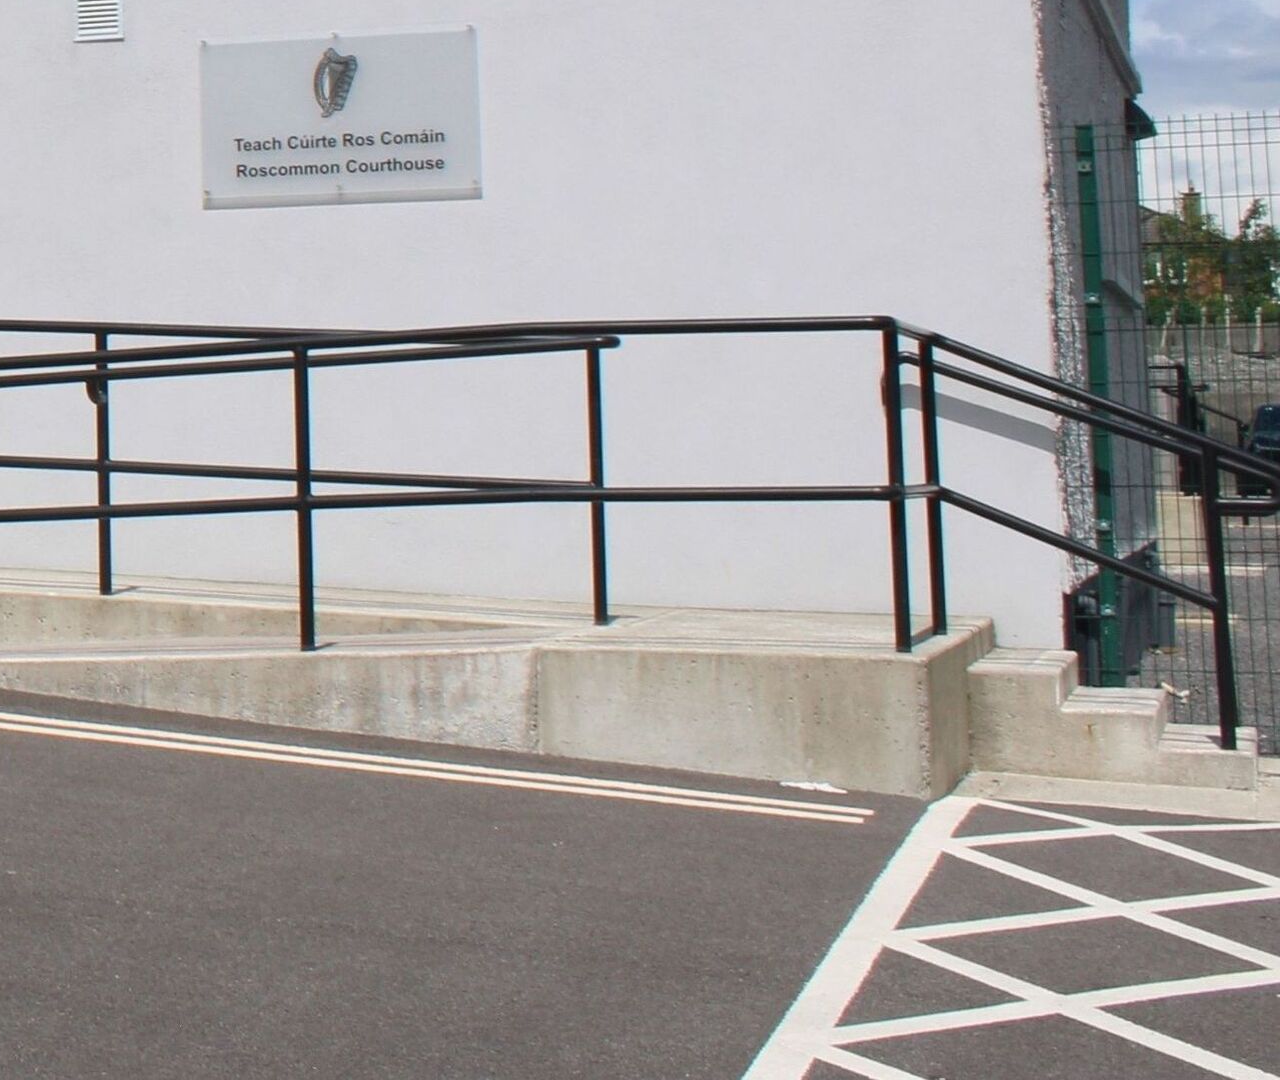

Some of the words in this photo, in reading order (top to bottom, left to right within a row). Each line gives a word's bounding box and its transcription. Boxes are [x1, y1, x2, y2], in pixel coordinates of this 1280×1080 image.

[234, 137, 282, 152] Teach
[287, 133, 337, 150] Cúirte
[343, 132, 375, 147] Ros
[380, 128, 445, 146] Comáin
[236, 162, 340, 178] Roscommon
[346, 157, 445, 173] Courthouse
